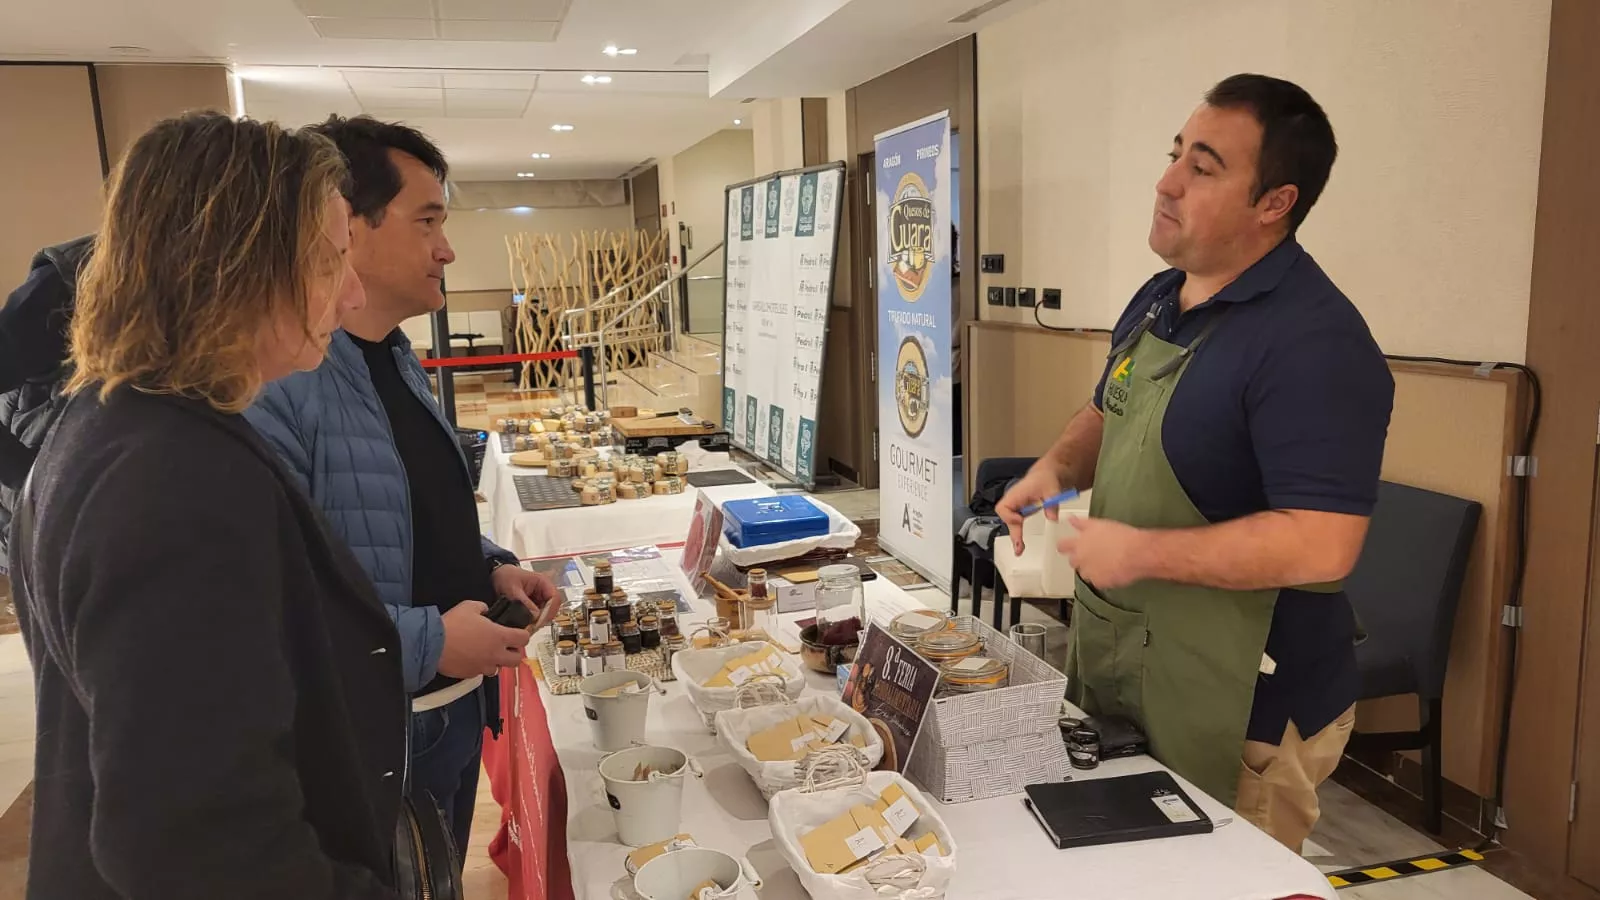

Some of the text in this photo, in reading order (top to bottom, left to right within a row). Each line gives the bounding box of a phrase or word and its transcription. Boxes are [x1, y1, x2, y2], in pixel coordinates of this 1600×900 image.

[890, 205, 932, 252] Guara
[903, 203, 922, 221] Quesos
[912, 312, 937, 329] NATURAL
[890, 443, 938, 485] GOURMET
[893, 659, 919, 692] FERIA
